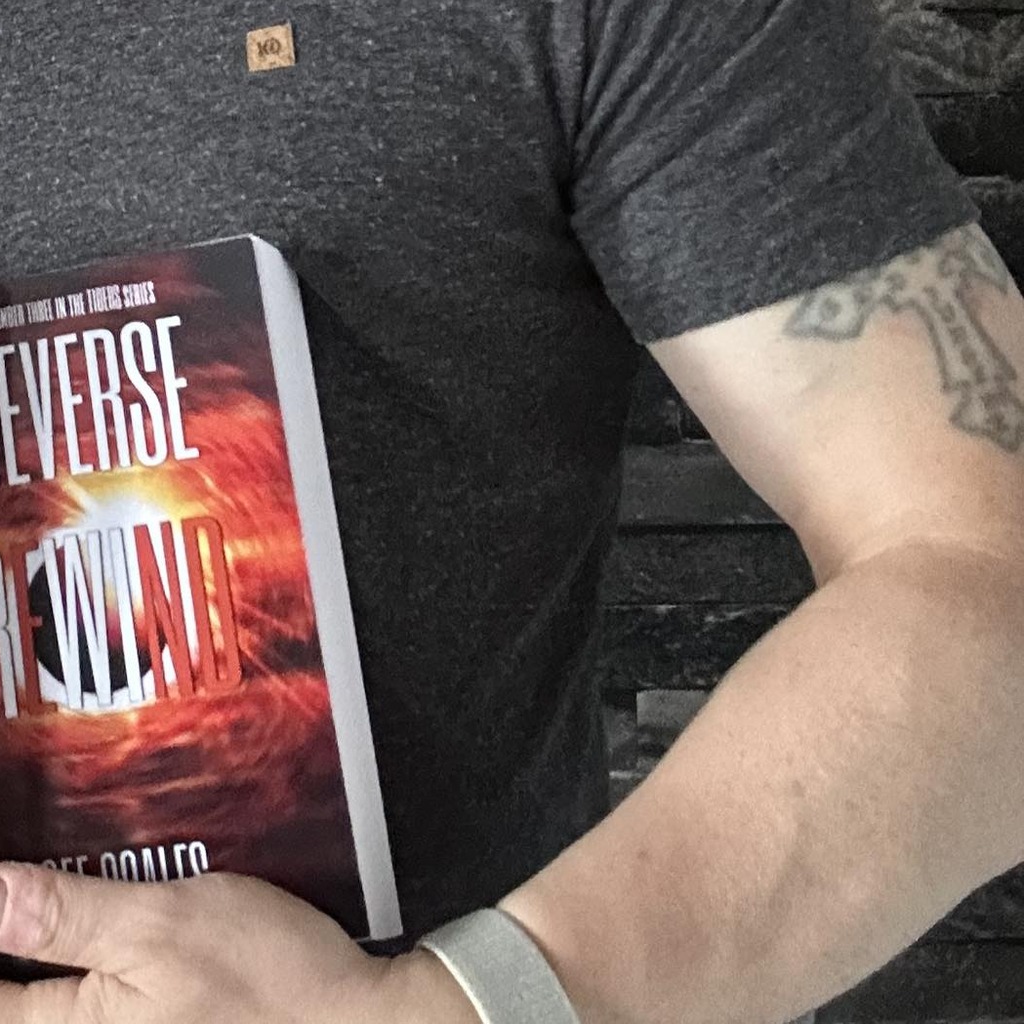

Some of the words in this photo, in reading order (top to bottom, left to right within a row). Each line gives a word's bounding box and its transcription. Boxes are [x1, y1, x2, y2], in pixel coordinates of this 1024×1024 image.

[26, 298, 54, 324] THREE
[54, 295, 67, 319] IN
[68, 292, 86, 318] THE
[123, 281, 156, 308] SERIES
